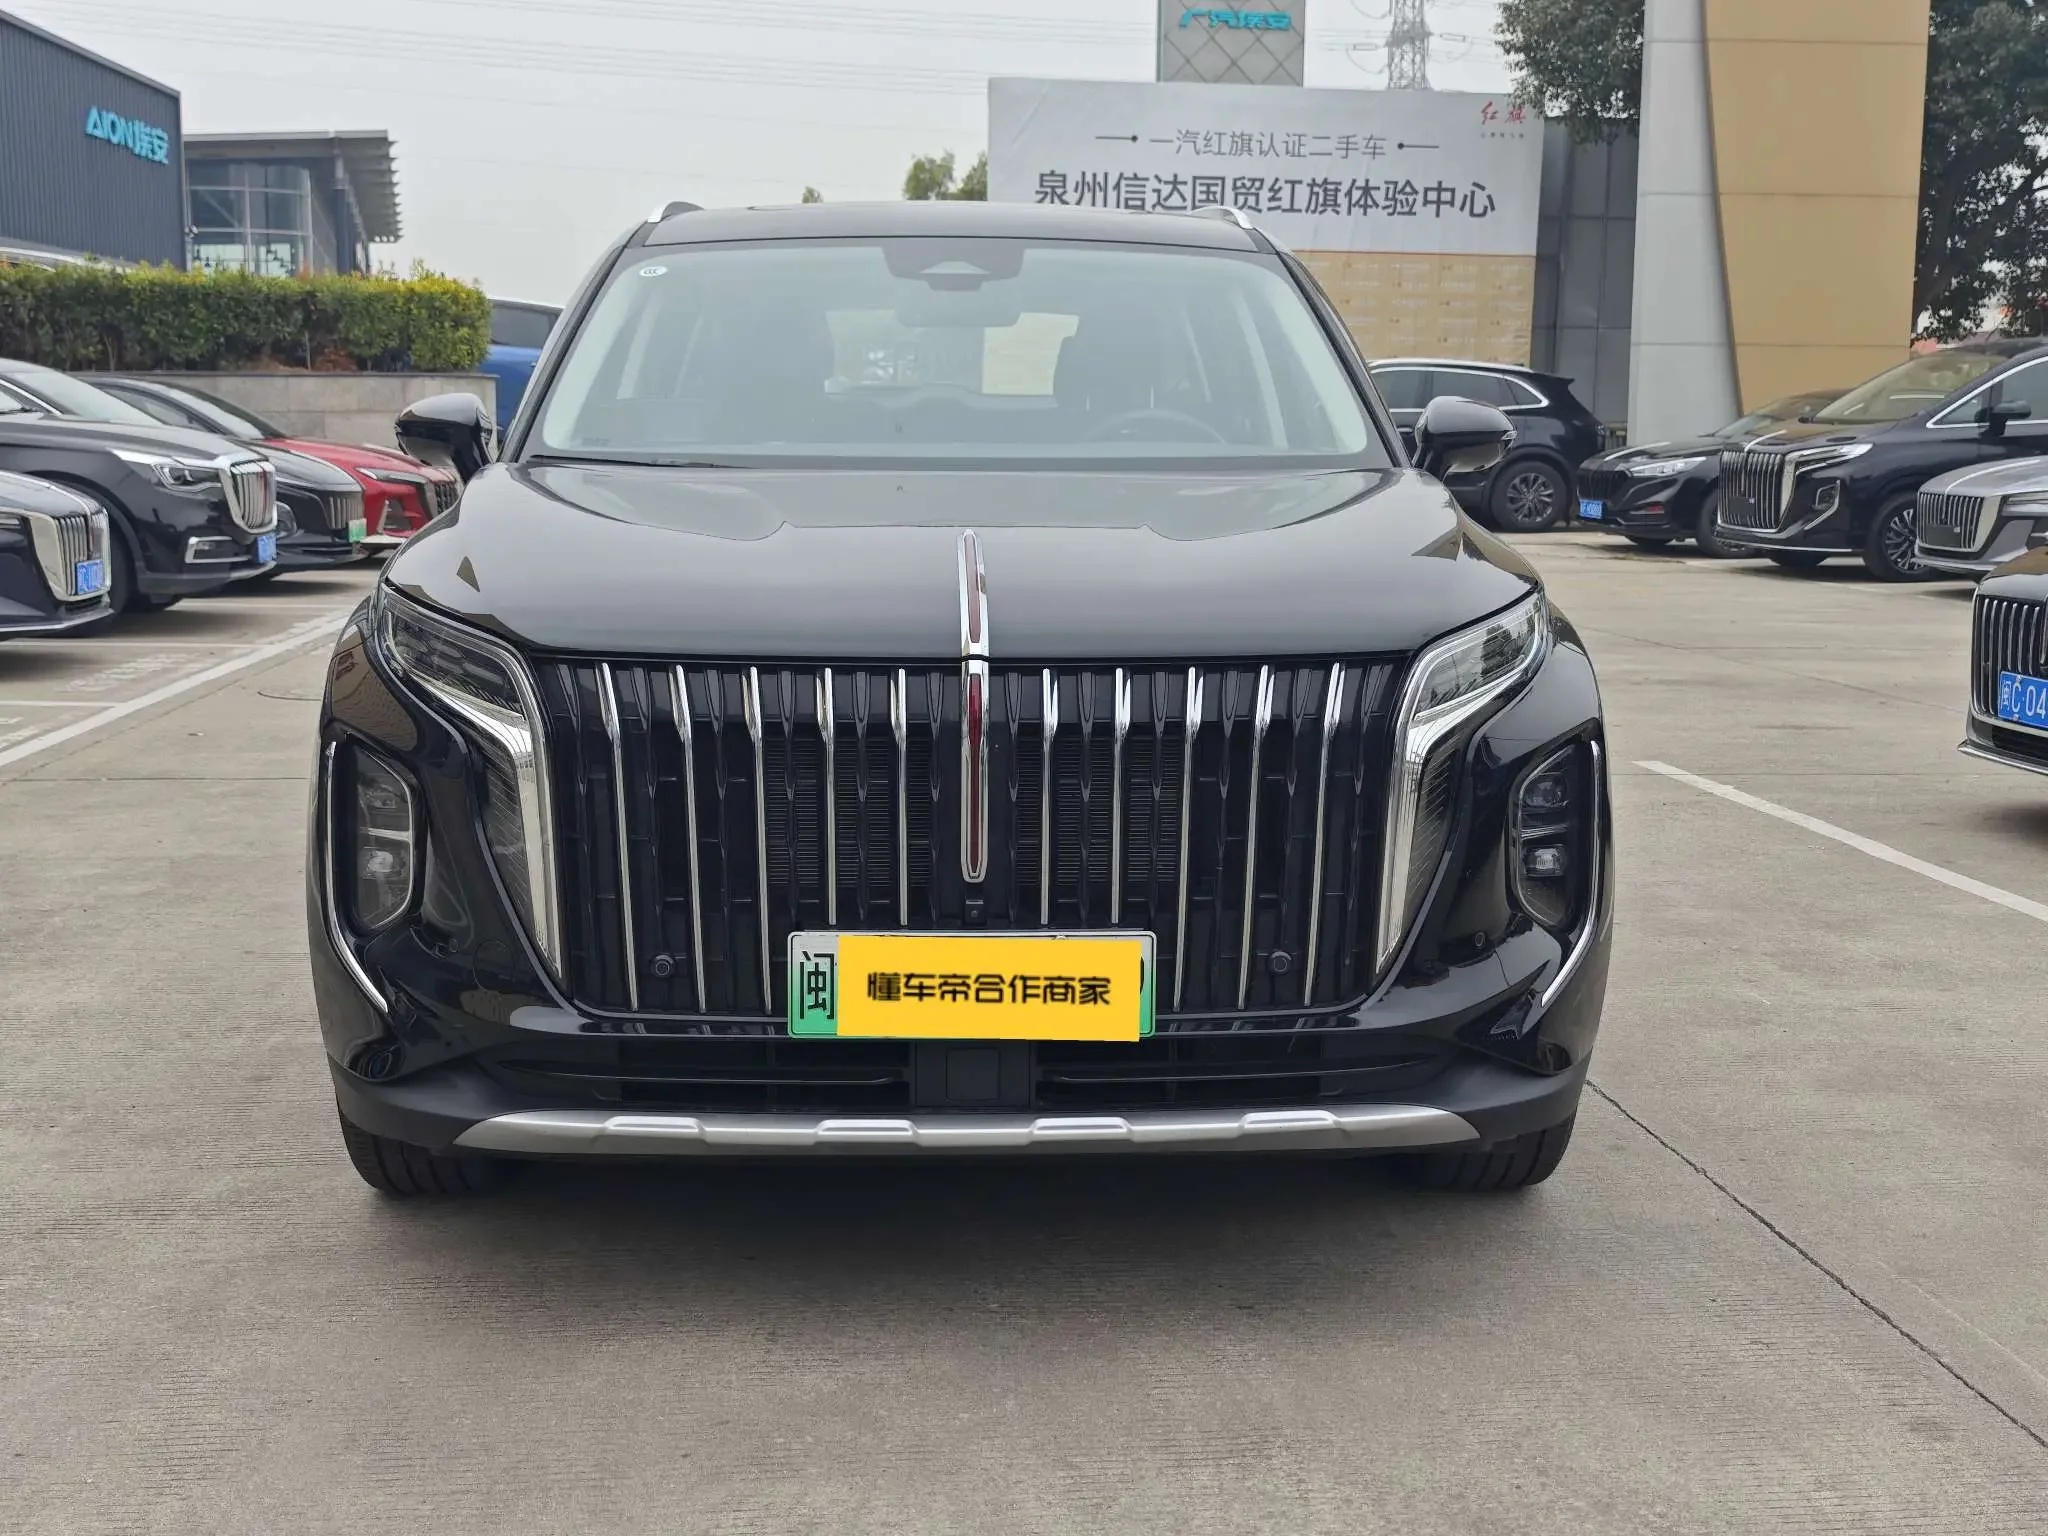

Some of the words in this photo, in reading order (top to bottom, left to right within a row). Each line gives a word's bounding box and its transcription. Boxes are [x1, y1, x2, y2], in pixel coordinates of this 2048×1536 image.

[1149, 129, 1387, 161] 一汽红旗认证二手车
[1034, 169, 1496, 219] 泉州信达国贸红旗体验中心
